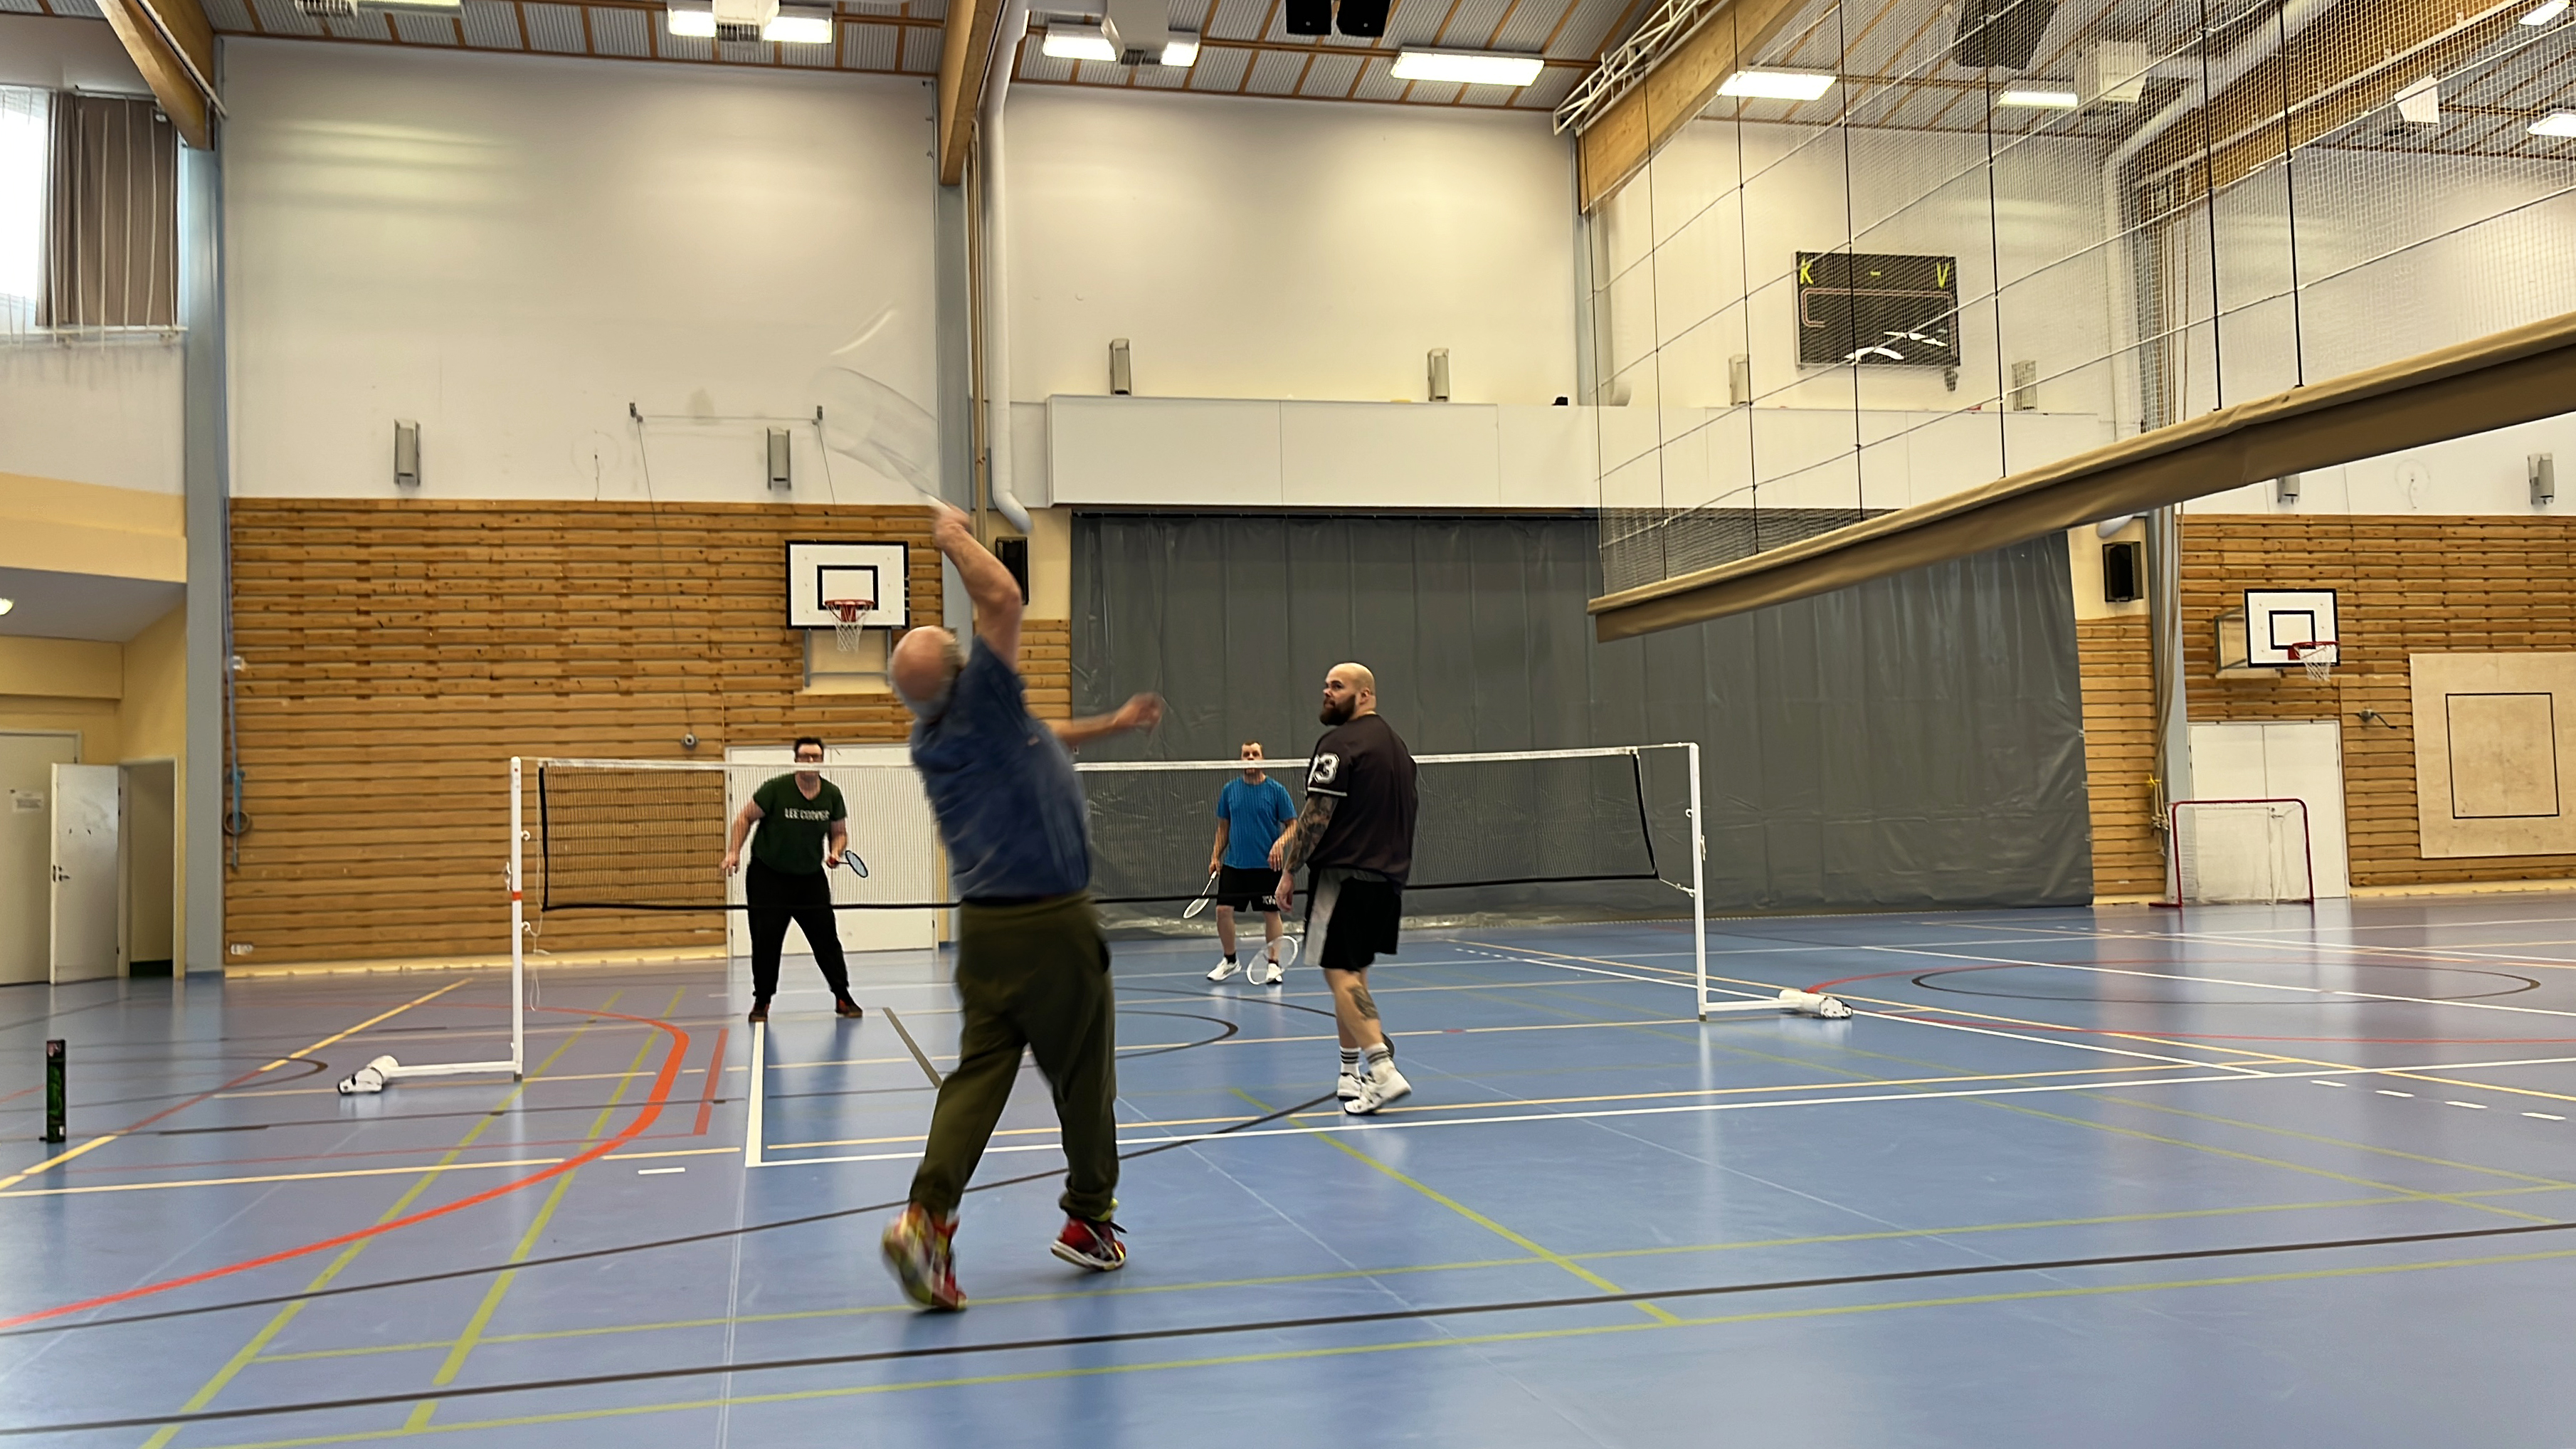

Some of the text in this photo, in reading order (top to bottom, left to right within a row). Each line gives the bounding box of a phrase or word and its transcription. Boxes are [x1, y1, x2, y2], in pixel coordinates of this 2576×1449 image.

[1800, 257, 1814, 285] K
[1936, 262, 1951, 288] V
[784, 807, 800, 819] LEE
